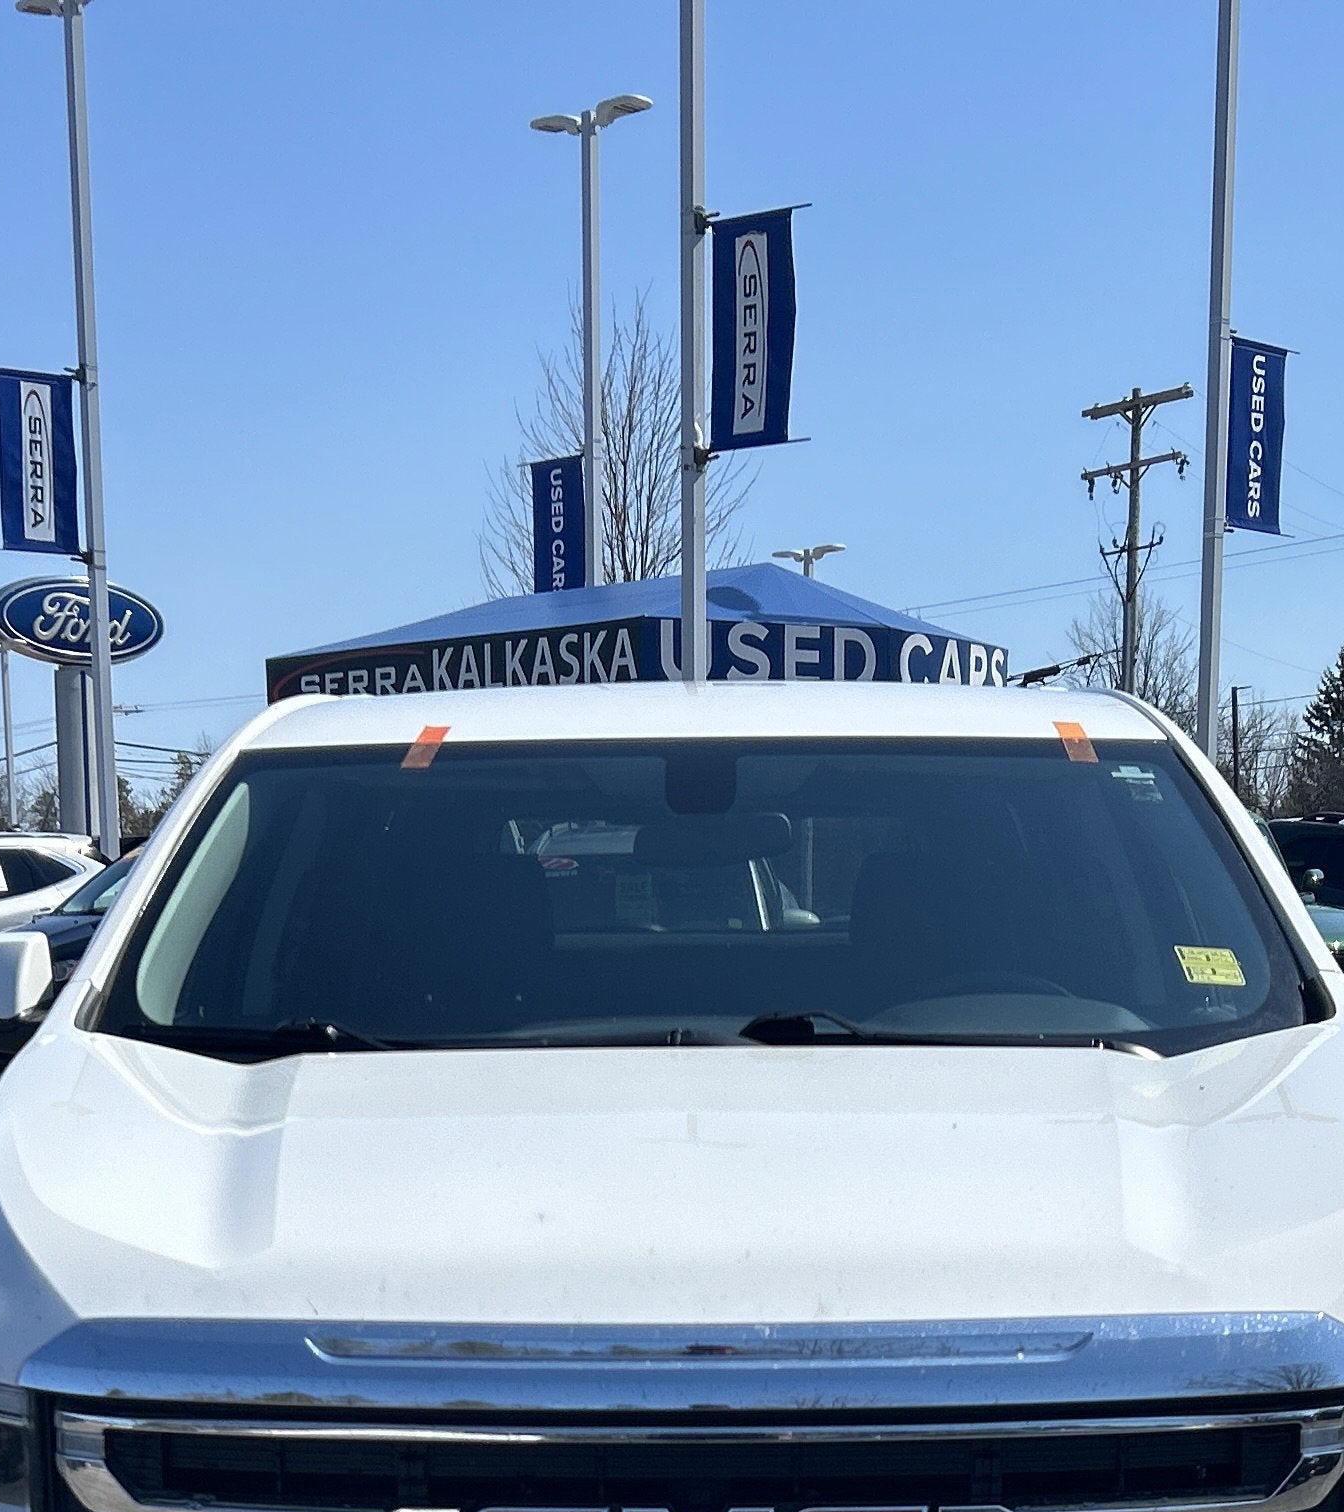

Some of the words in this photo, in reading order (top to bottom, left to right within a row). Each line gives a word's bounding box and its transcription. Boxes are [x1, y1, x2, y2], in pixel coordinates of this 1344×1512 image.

[740, 273, 758, 420] SERRA
[1250, 354, 1266, 433] USED
[28, 415, 45, 528] SERRA
[550, 468, 564, 533] USED
[1247, 440, 1263, 519] CARS
[552, 539, 565, 591] CAR
[33, 591, 133, 646] Fod
[660, 618, 877, 682] USED
[899, 633, 1006, 688] CARS
[300, 663, 427, 695] SERRA
[432, 627, 639, 691] KALKASKA
